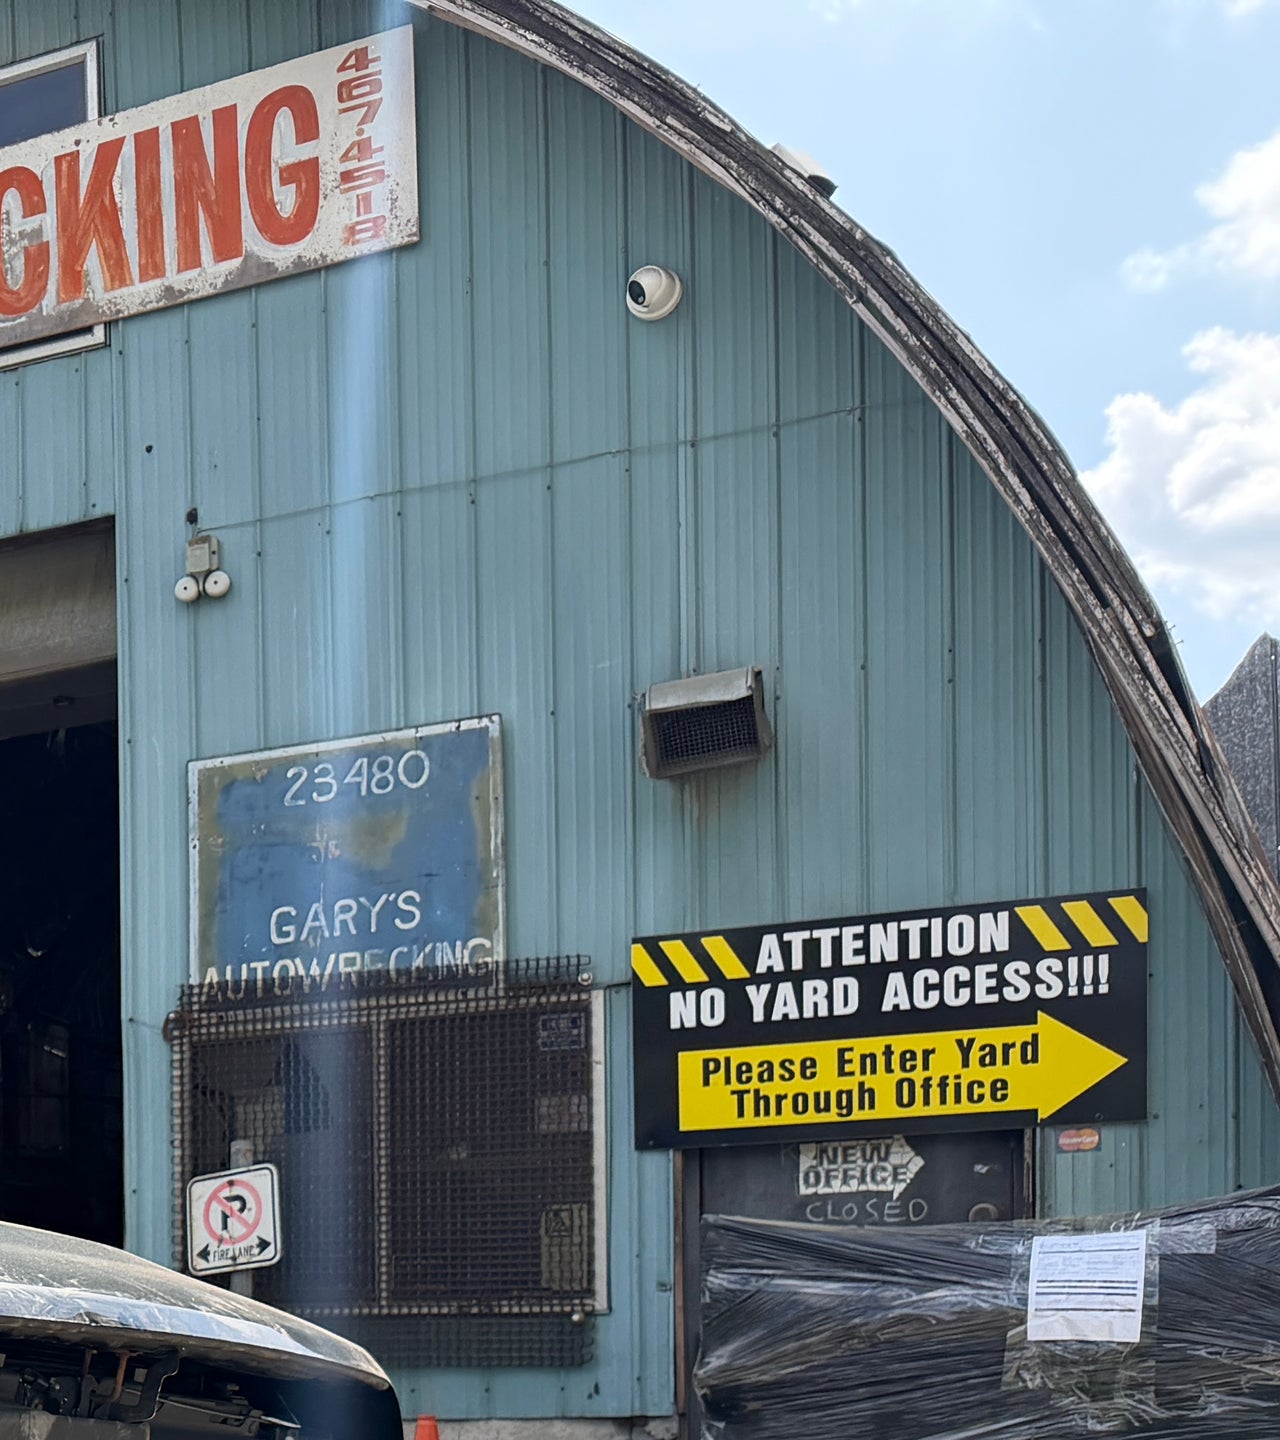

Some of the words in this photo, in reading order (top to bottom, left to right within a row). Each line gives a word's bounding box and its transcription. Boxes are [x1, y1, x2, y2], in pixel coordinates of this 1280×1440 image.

[284, 749, 430, 807] 23480
[269, 889, 421, 945] GARY'S
[755, 911, 1010, 975] ATTENTION
[669, 987, 726, 1030] NO
[745, 975, 859, 1023] YARD
[881, 954, 1109, 1012] ACCESS!!!
[702, 1056, 818, 1087] Please
[837, 1045, 936, 1078] Enter
[955, 1032, 1040, 1069] Yard
[730, 1082, 878, 1120] Through
[895, 1075, 1010, 1107] Office
[803, 1165, 908, 1190] OFFICE
[819, 1143, 891, 1166] NEW
[806, 1198, 928, 1222] CLOSED
